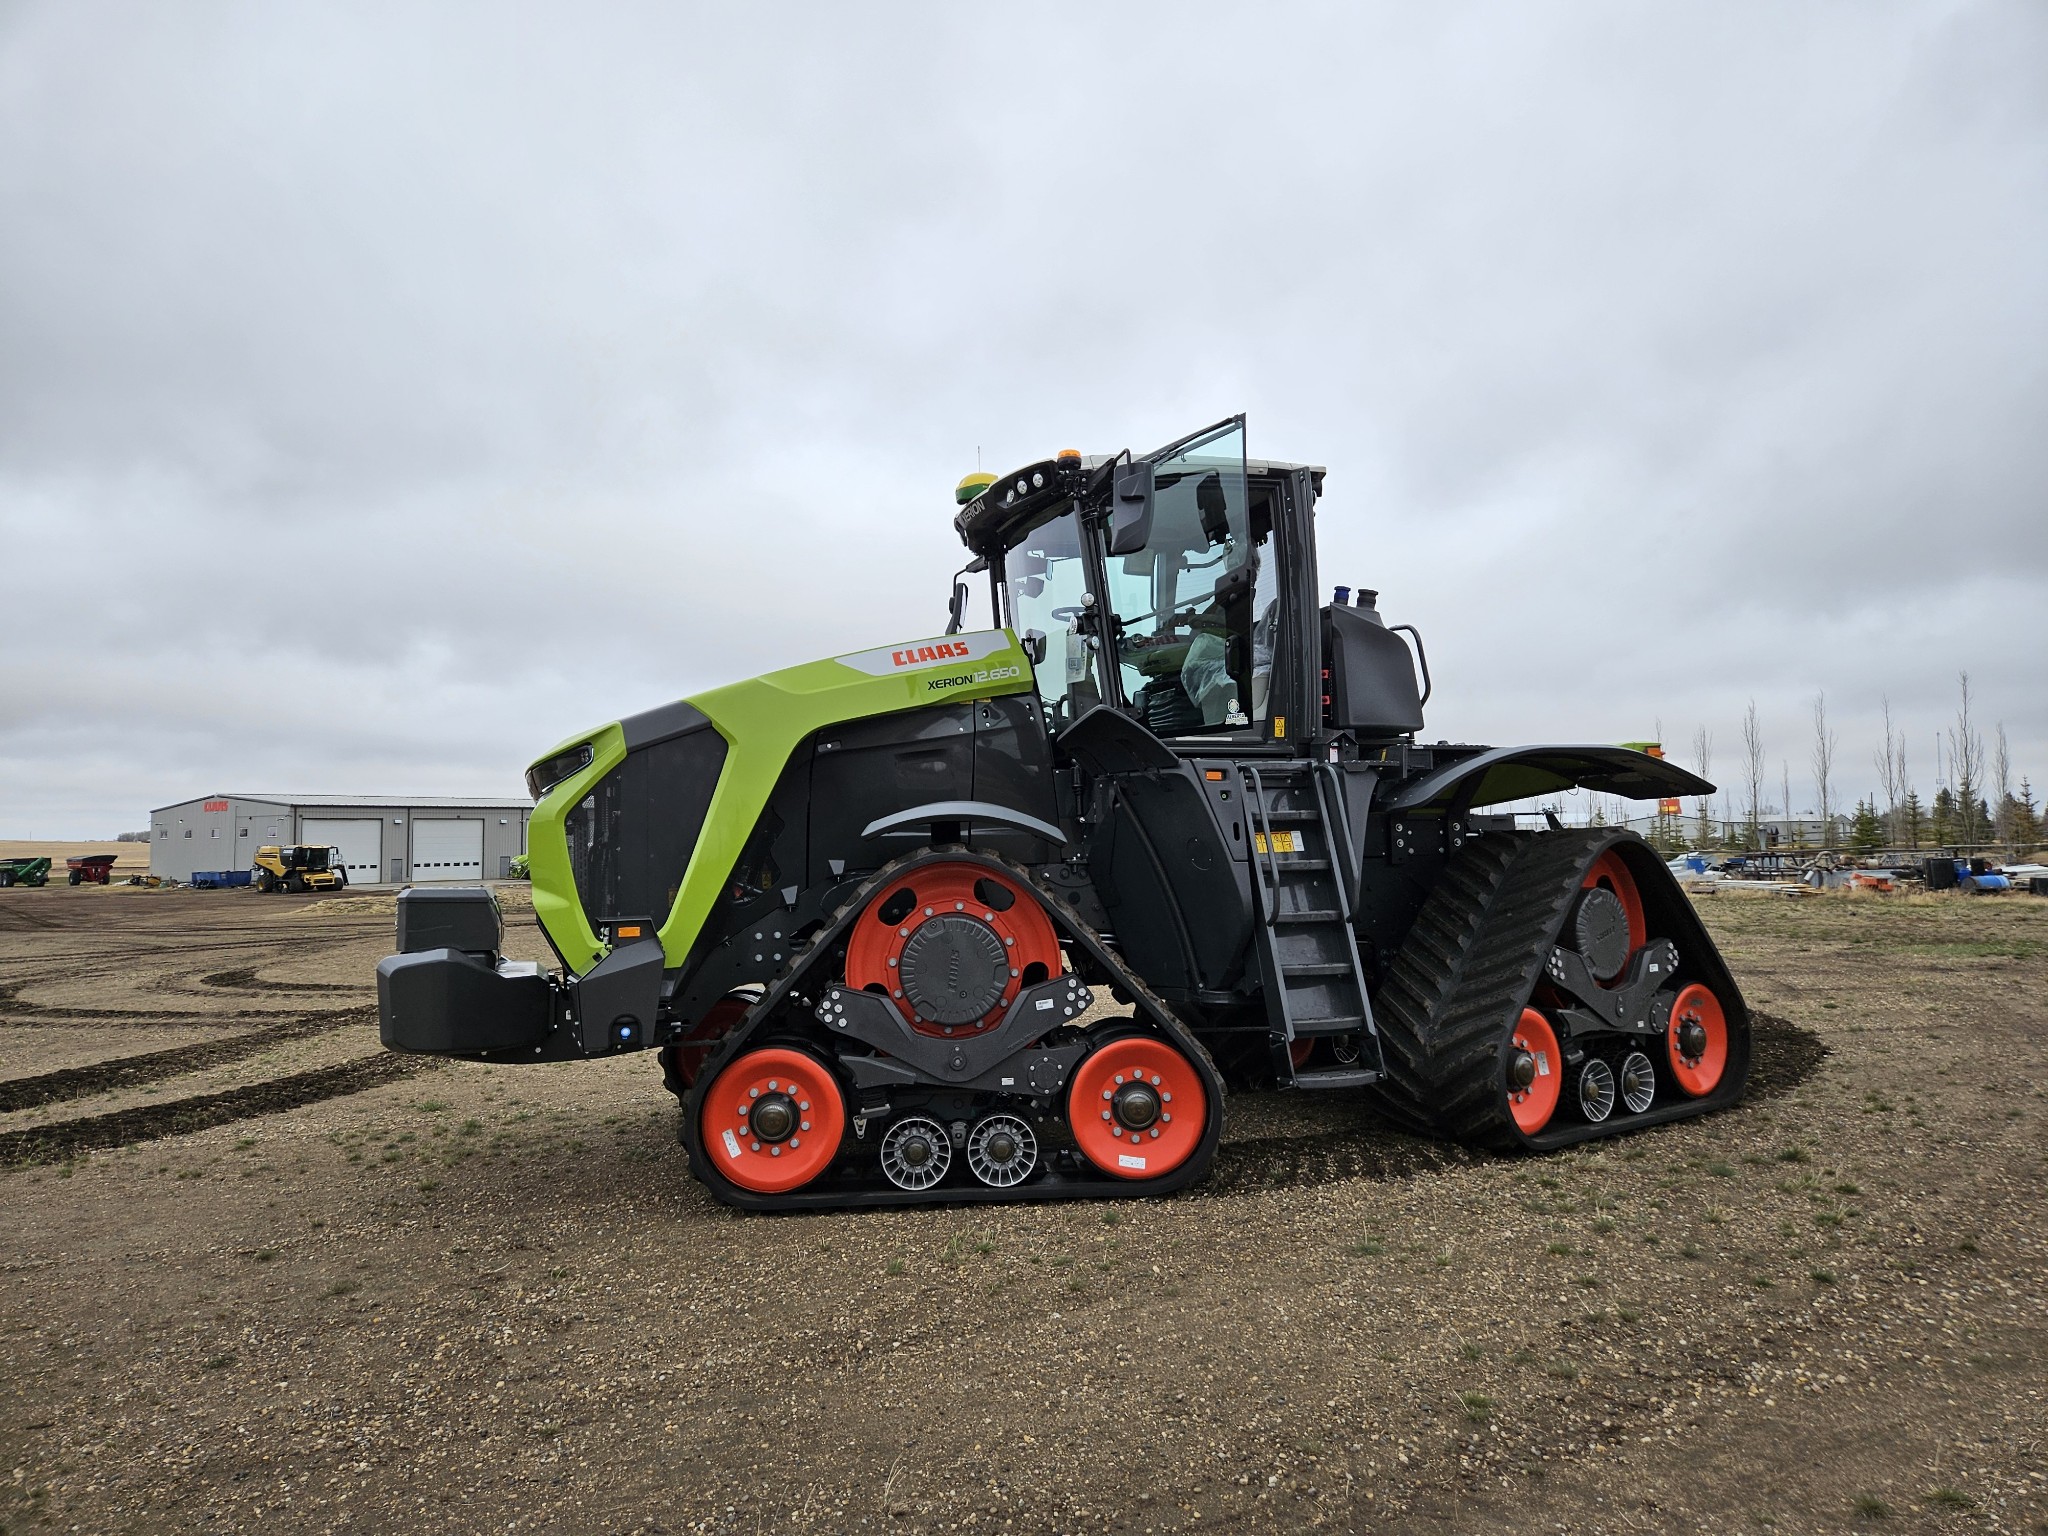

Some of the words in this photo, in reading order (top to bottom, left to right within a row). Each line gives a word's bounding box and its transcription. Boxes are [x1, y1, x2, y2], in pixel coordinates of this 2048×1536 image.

[892, 642, 969, 667] CLAAS
[927, 675, 973, 691] XERION
[973, 666, 1019, 683] 12.650
